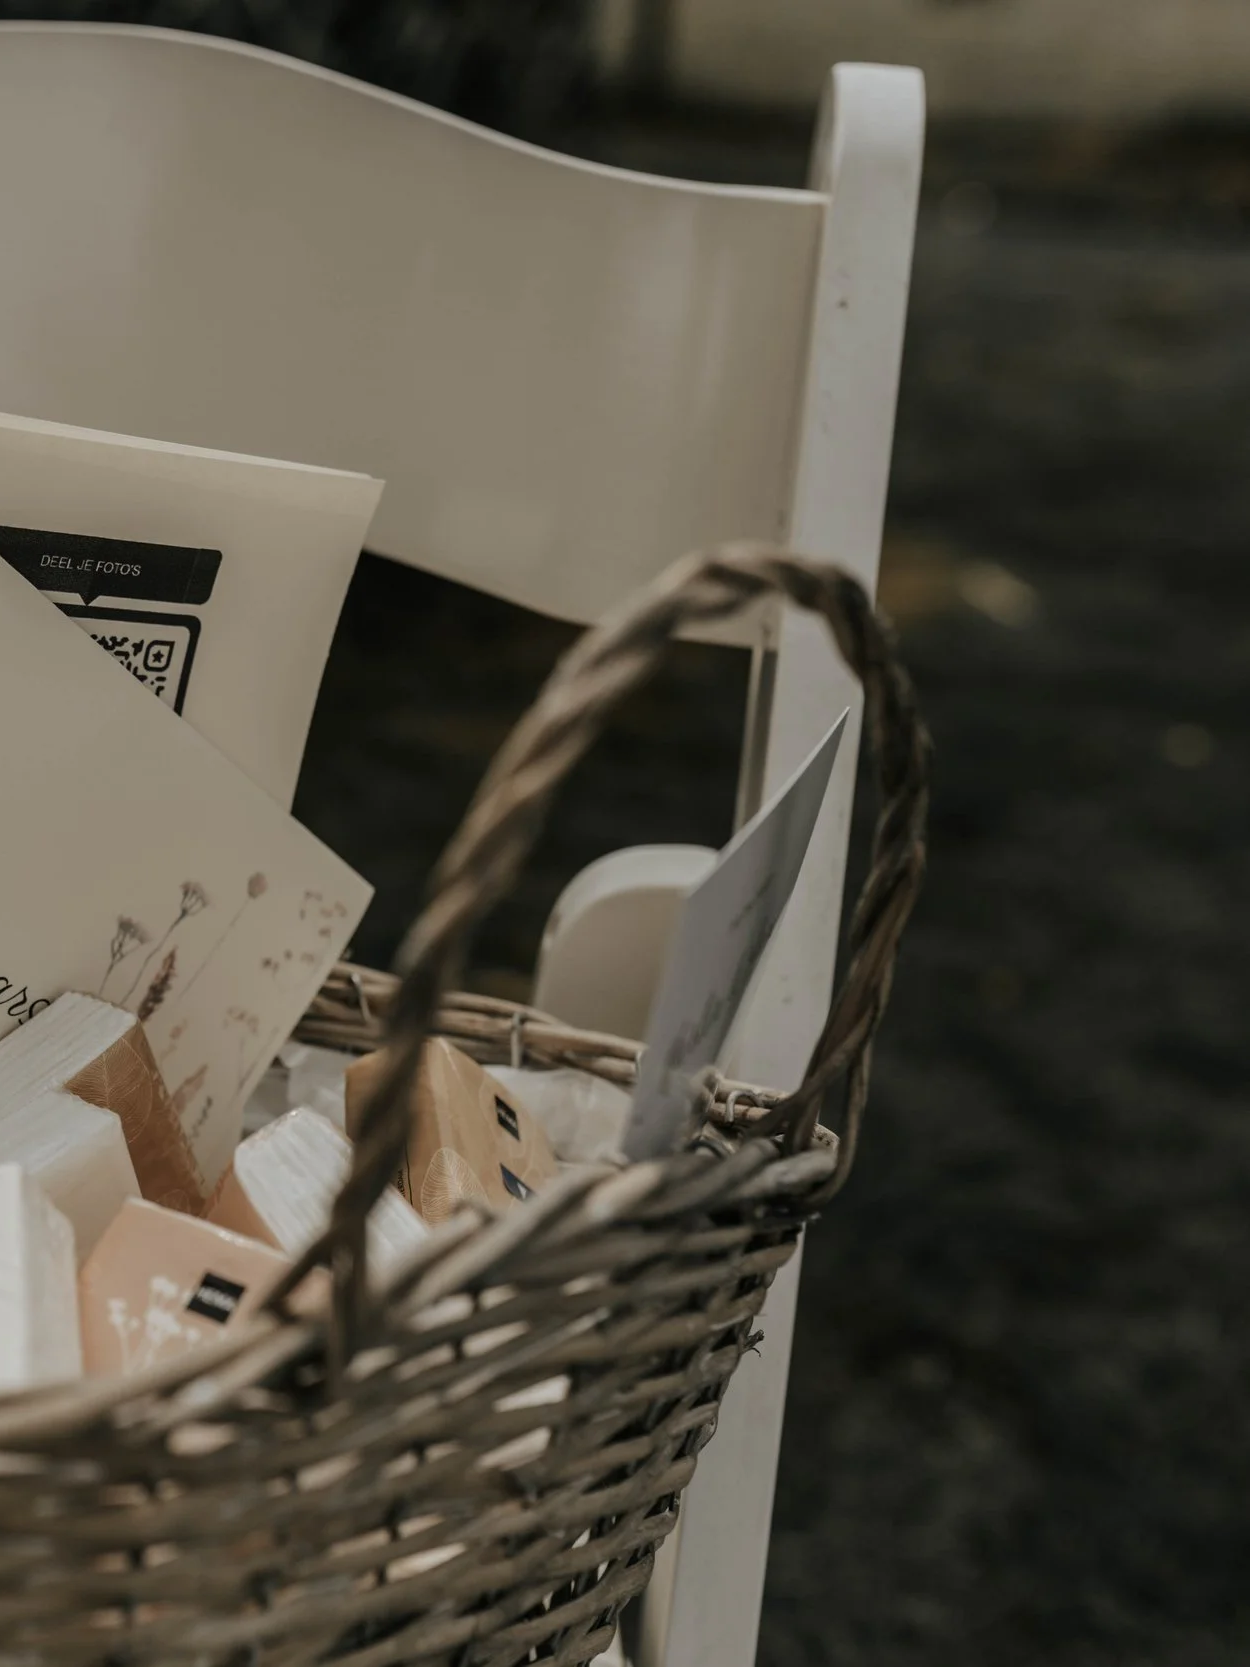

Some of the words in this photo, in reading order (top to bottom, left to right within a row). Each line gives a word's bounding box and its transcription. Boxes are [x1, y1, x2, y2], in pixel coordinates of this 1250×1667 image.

[40, 554, 74, 570] DEEL
[76, 559, 94, 572] JE
[95, 560, 142, 577] FOTO'S
